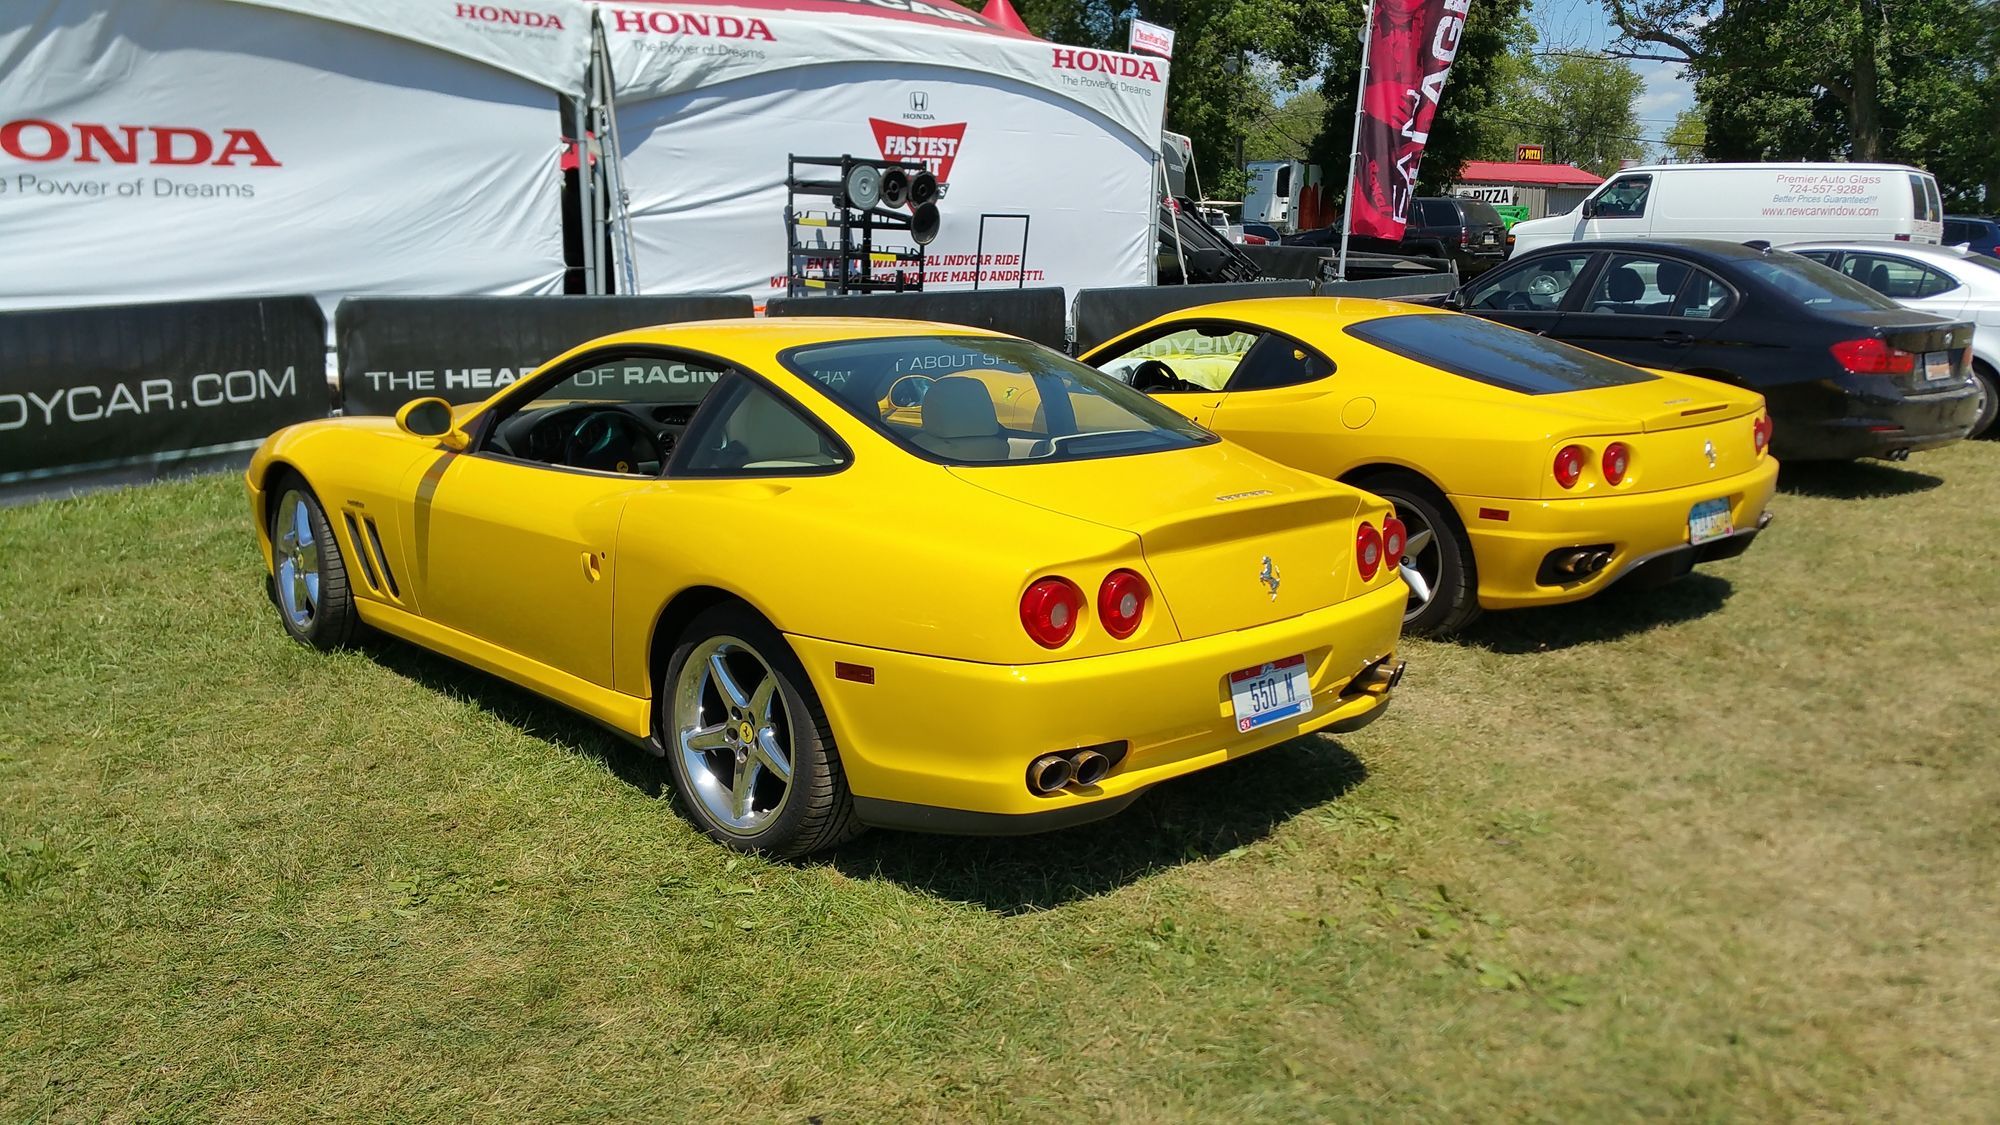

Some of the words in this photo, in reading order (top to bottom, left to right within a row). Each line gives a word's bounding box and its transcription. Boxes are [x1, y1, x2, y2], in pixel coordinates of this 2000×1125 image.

[455, 3, 565, 30] HONDA
[612, 9, 777, 41] HONDA
[633, 39, 657, 52] The
[660, 40, 700, 55] Power
[719, 44, 766, 59] Dreams
[1052, 48, 1162, 82] HONDA
[1061, 75, 1078, 86] The
[1080, 77, 1109, 89] Power
[1121, 82, 1151, 96] Dreams
[884, 136, 958, 157] FASTEST
[18, 174, 106, 197] Power
[117, 178, 144, 197] of
[154, 177, 255, 198] Dreams
[1776, 174, 1818, 184] Premier
[1820, 174, 1846, 184] Auto
[1849, 174, 1882, 184] Glass
[1473, 188, 1510, 204] PIZZA
[1772, 193, 1796, 203] Better
[1797, 194, 1820, 203] Prices
[1788, 184, 1865, 195] 724-557-9288
[1761, 204, 1879, 217] www.newcarwindow.com
[943, 253, 992, 266] INDYCAR
[994, 254, 1020, 266] RIDE
[923, 271, 949, 283] LIKE
[950, 270, 987, 282] MARO
[909, 353, 978, 371] ABOUT
[365, 370, 436, 392] THE
[445, 367, 536, 390] HEA
[573, 368, 616, 388] OF
[623, 364, 726, 385] RACIN
[1249, 677, 1278, 713] 550
[1240, 718, 1251, 730] 51
